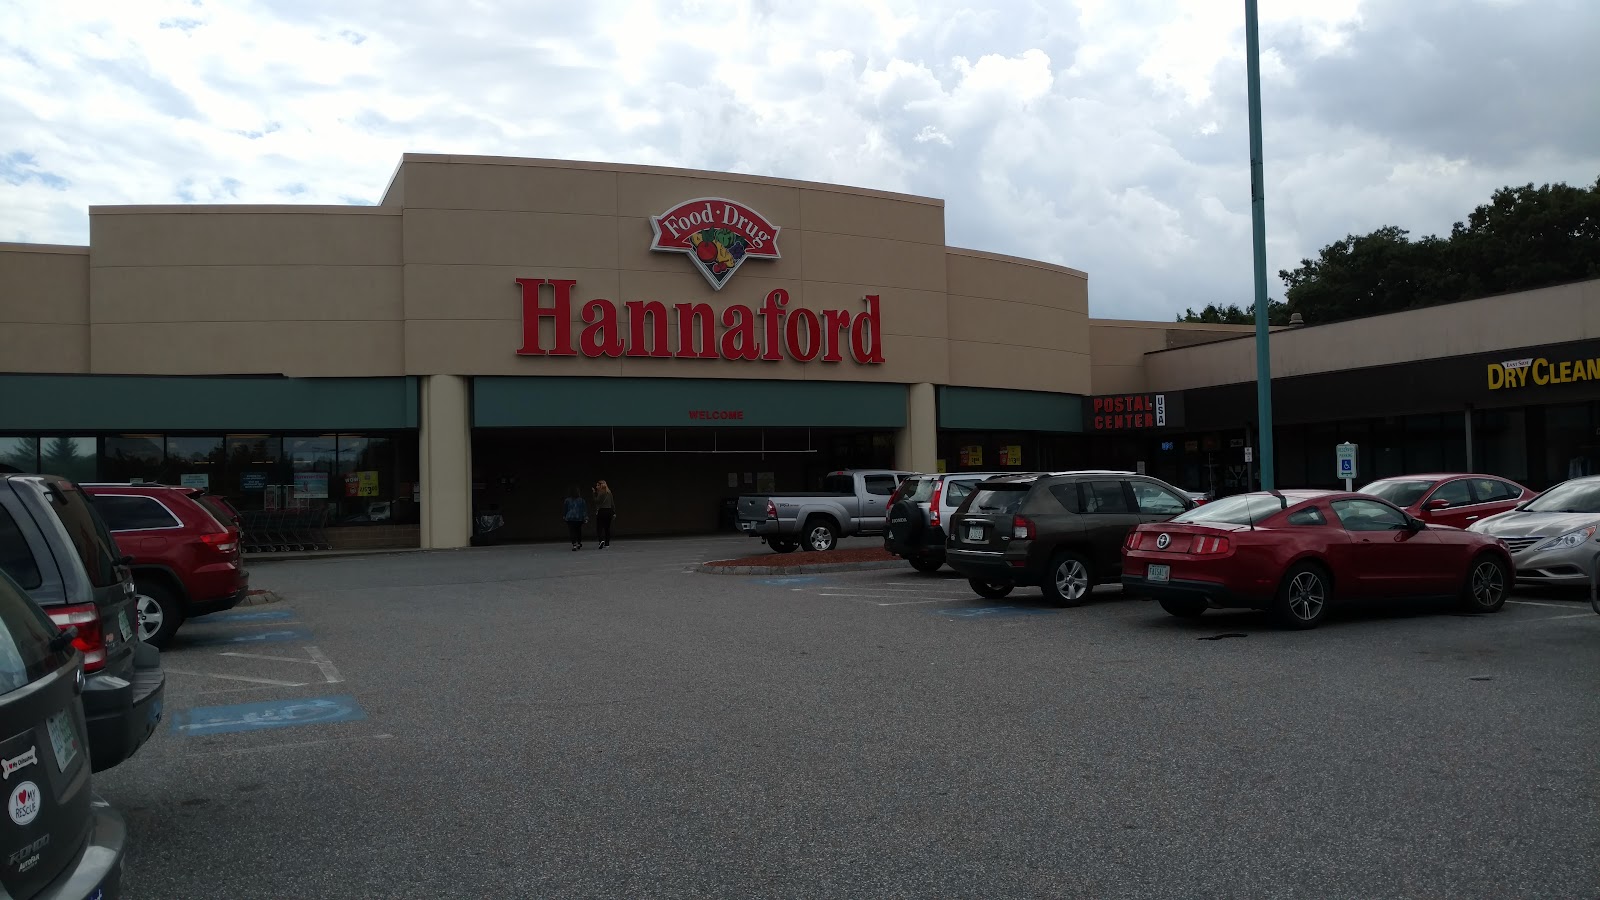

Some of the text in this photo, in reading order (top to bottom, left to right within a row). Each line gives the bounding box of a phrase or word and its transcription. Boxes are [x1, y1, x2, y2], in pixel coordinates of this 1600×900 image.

[663, 203, 770, 248] Food Drug
[515, 278, 885, 364] Hannaford
[1487, 363, 1529, 390] DRY
[1093, 395, 1153, 413] POSTAL
[689, 411, 744, 420] WELCOME
[1094, 413, 1154, 430] CENTER
[15, 788, 36, 807] I MY
[15, 802, 36, 818] RESCUE
